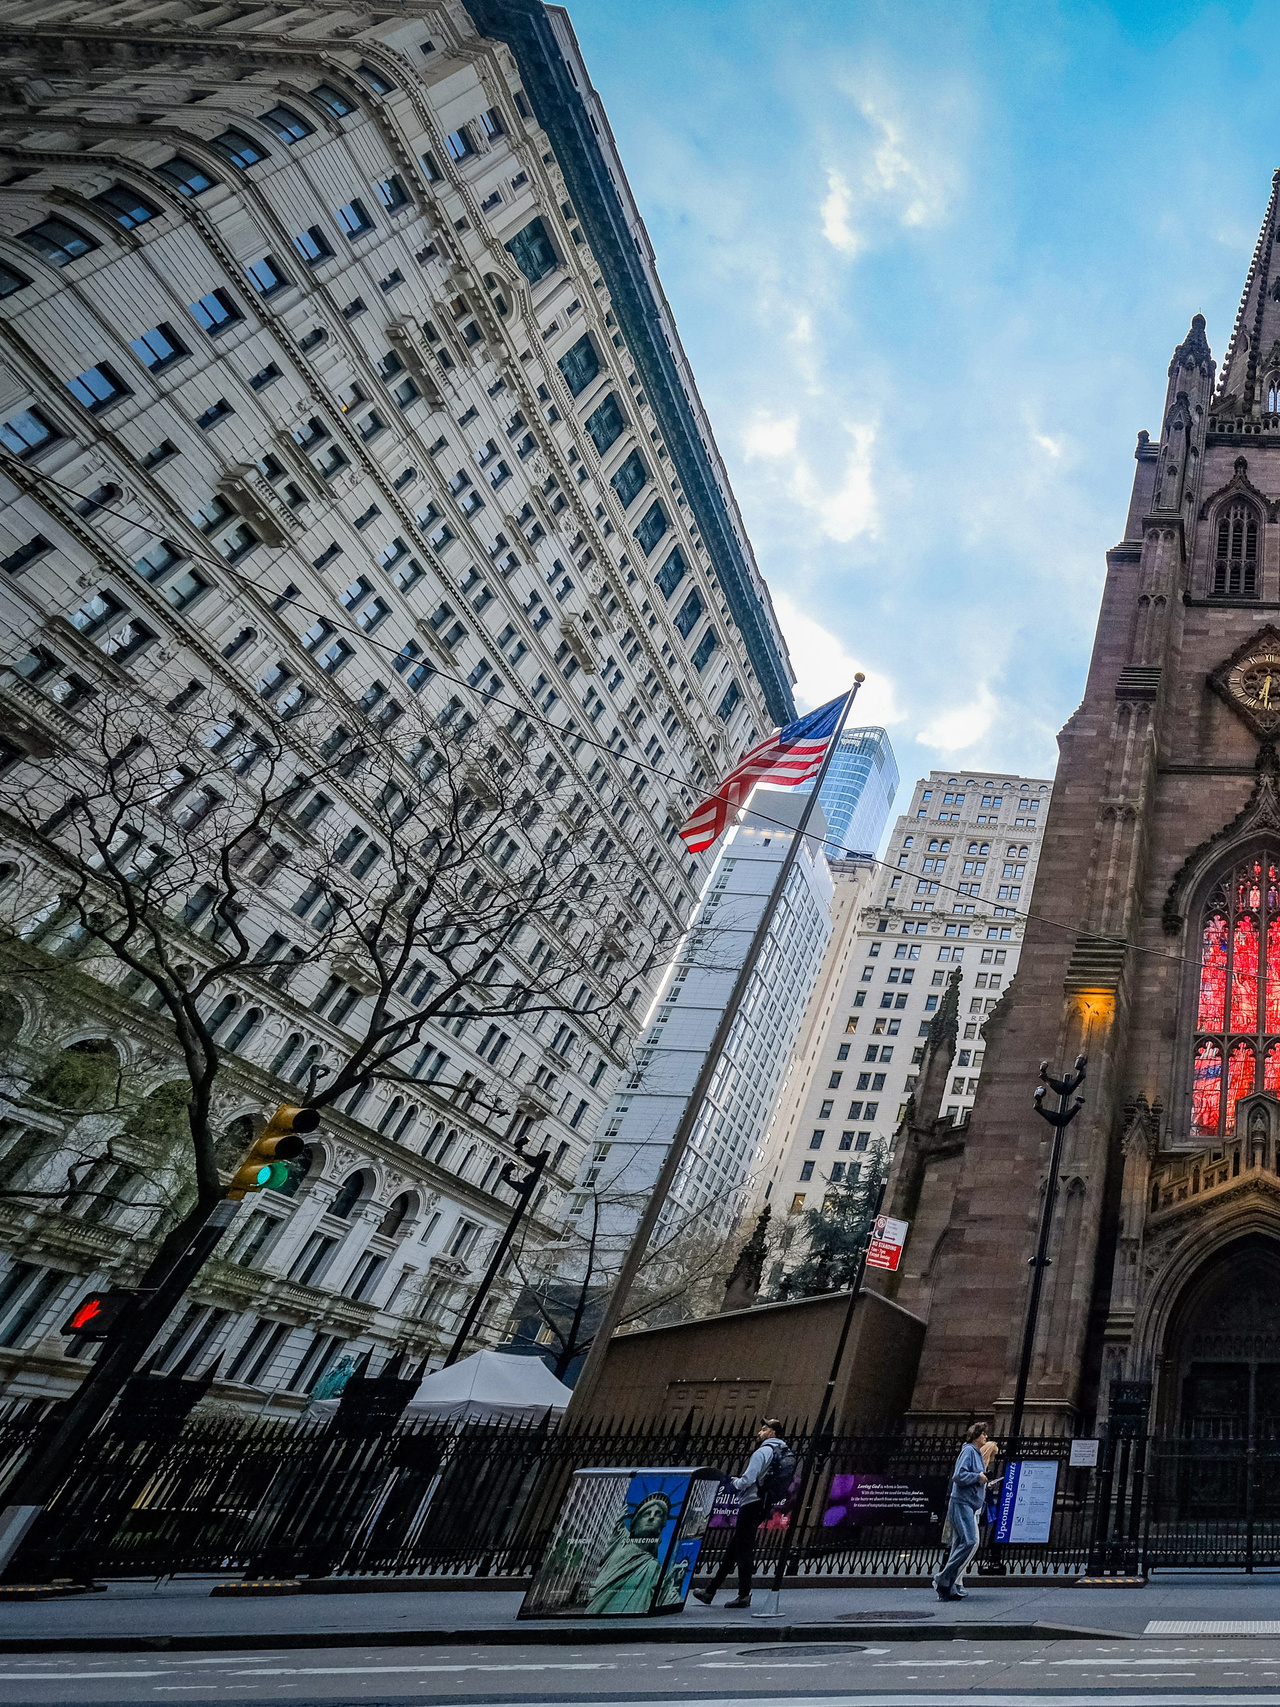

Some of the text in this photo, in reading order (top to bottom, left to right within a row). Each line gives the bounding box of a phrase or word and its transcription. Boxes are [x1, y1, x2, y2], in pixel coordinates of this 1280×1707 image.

[713, 1508, 732, 1517] Trinity
[997, 1462, 1017, 1540] Upcoming Events
